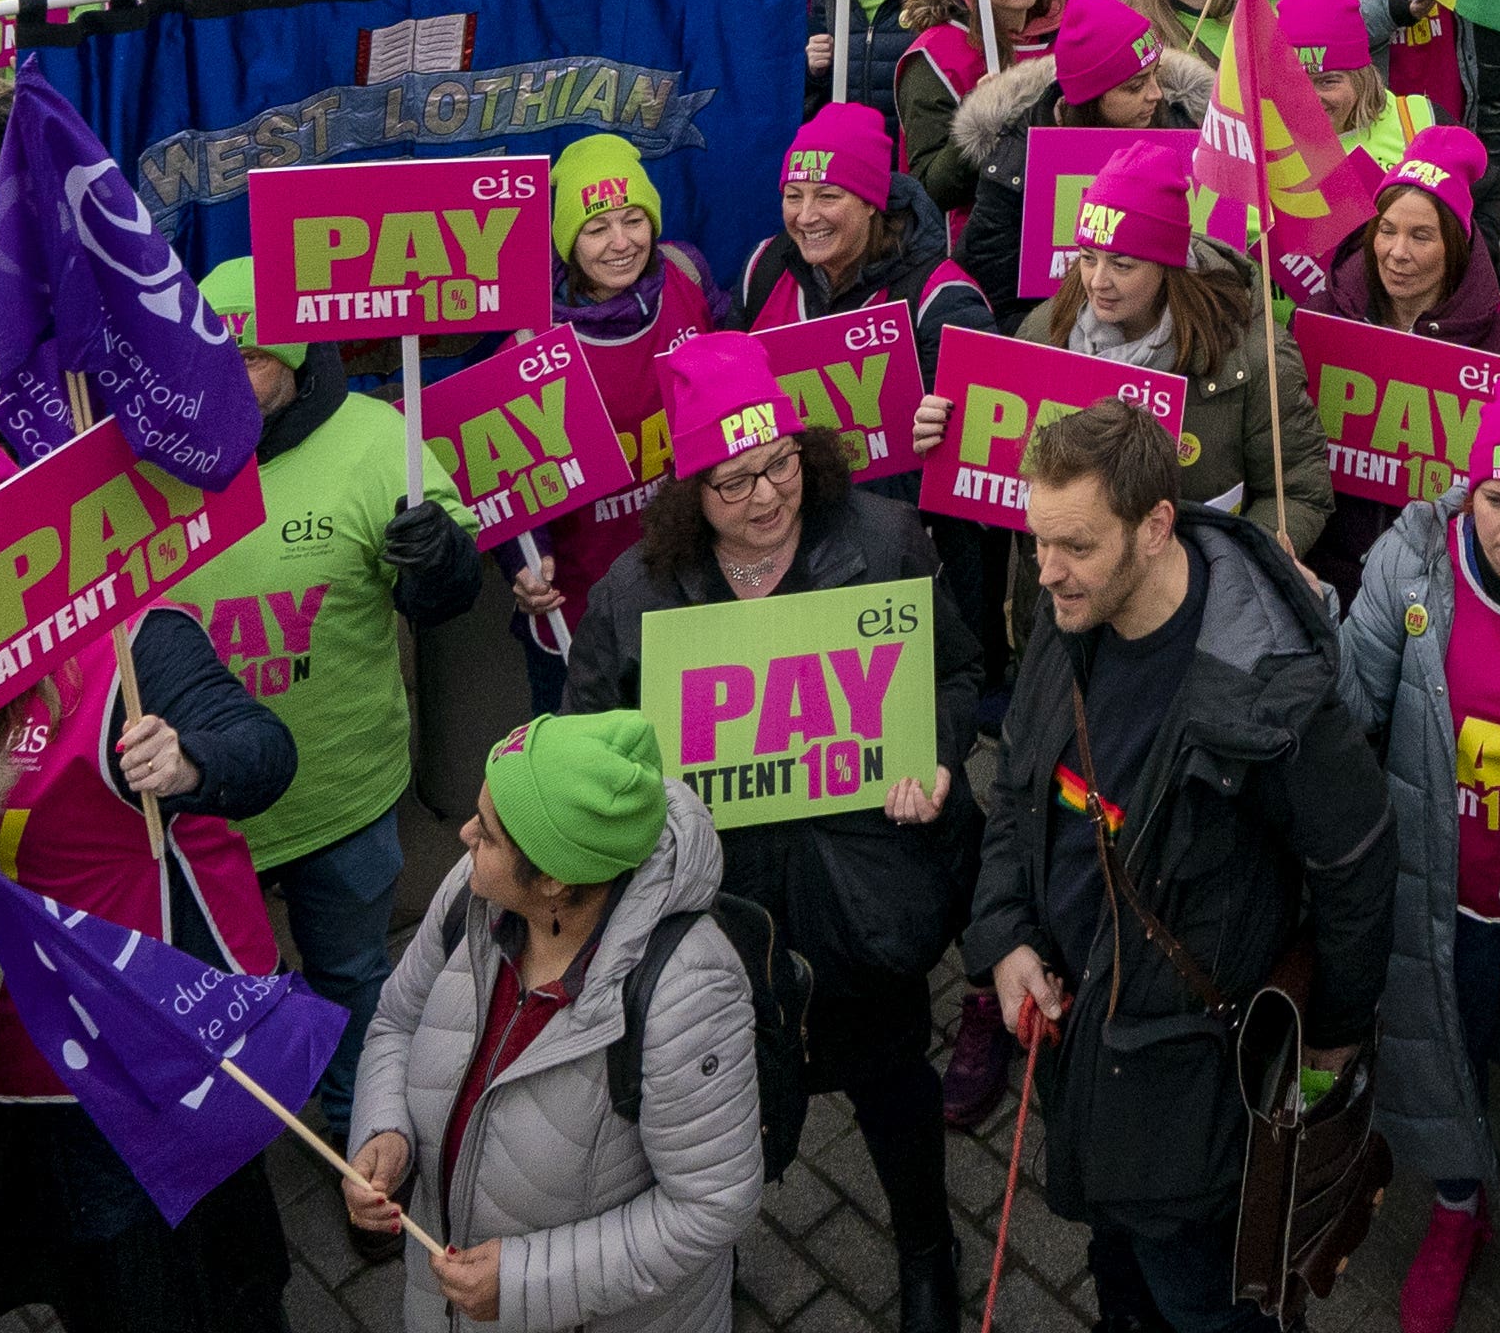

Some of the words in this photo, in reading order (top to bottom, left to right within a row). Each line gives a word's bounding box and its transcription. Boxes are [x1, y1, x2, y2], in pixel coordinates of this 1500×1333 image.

[140, 104, 355, 207] WEST
[386, 65, 679, 137] LOTHIAN
[472, 174, 537, 201] eis
[294, 205, 522, 292] PAY
[855, 599, 919, 639] eis
[679, 641, 905, 765] PAY
